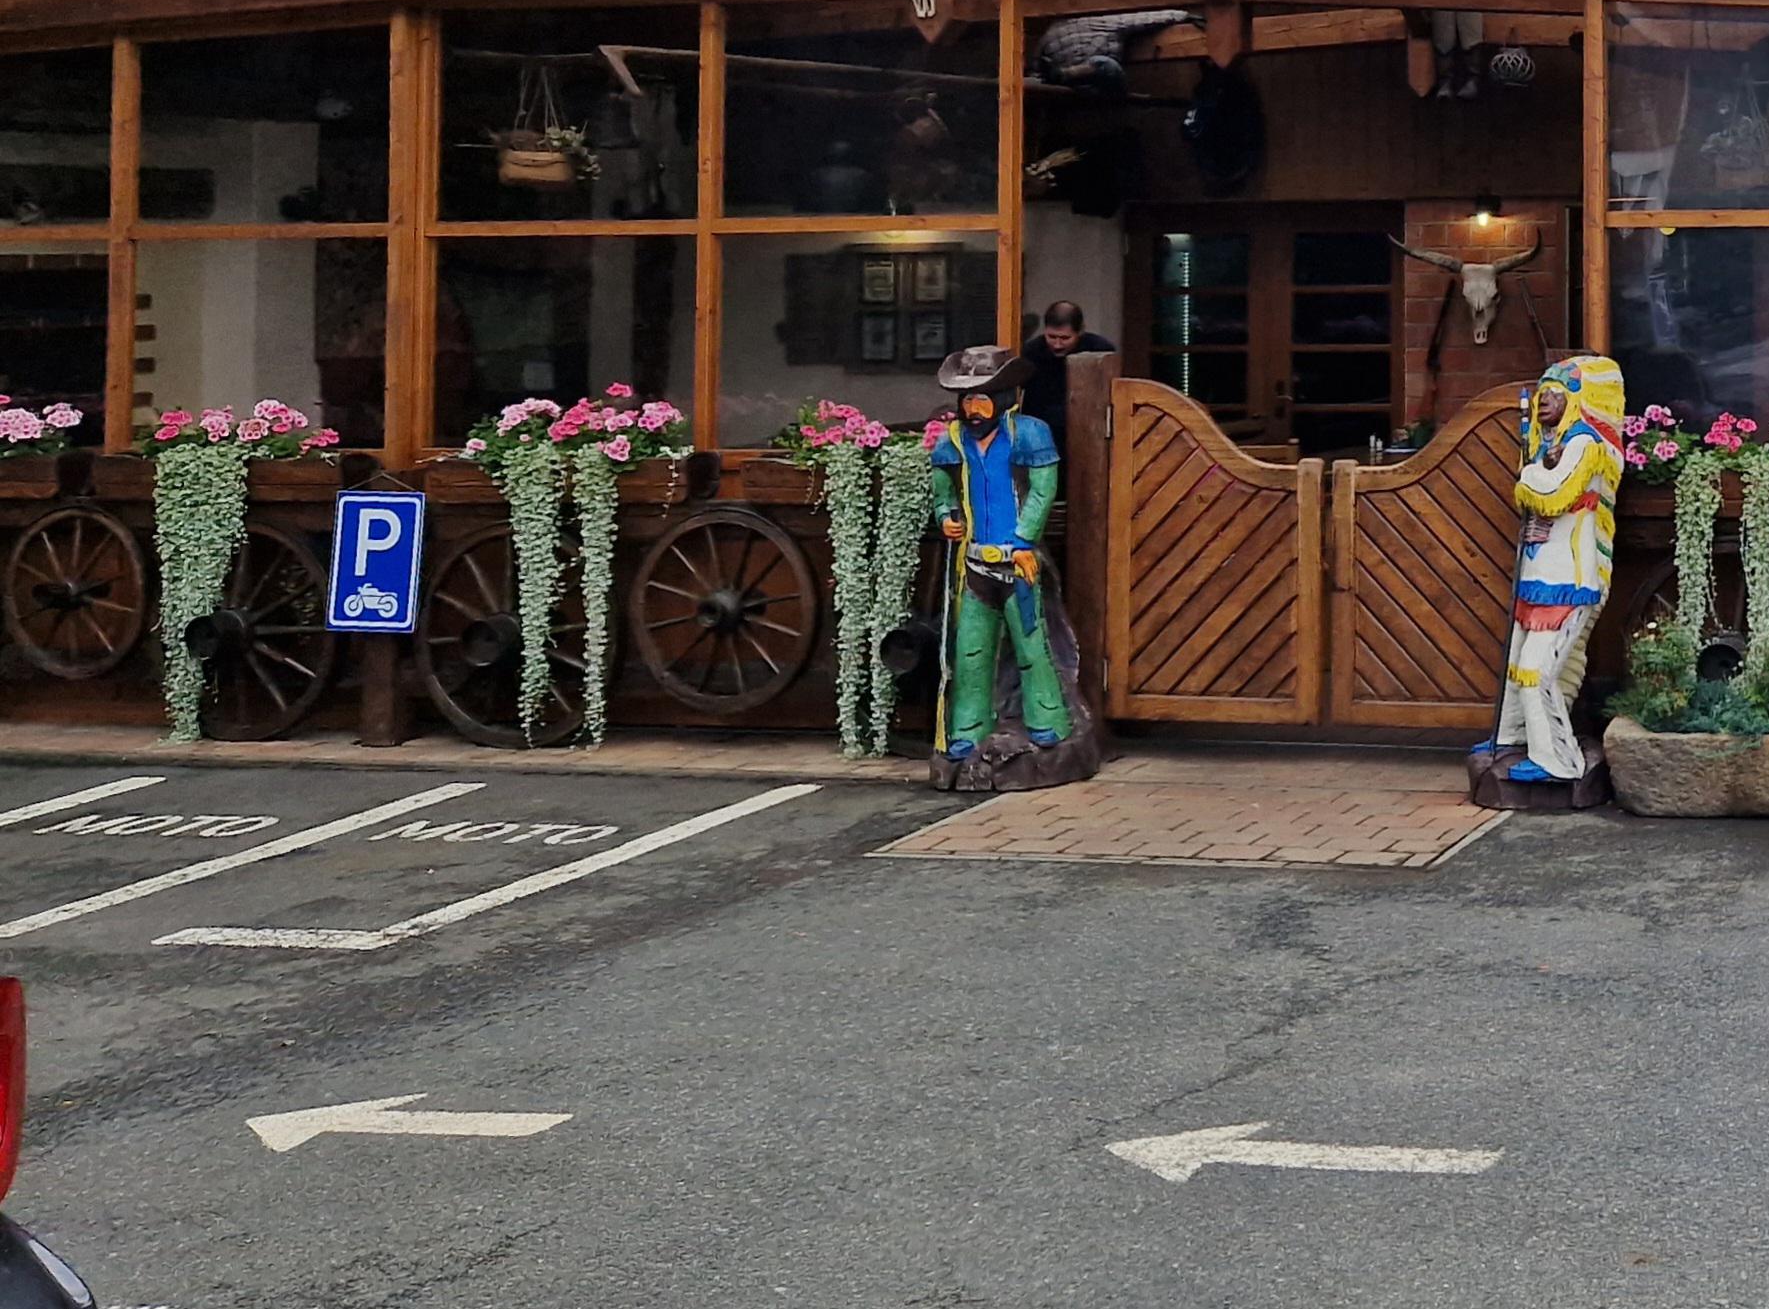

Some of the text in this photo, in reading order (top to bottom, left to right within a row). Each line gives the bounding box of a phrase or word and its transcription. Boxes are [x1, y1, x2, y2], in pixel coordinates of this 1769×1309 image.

[354, 508, 402, 576] P
[32, 813, 280, 838] MOTO
[368, 818, 620, 846] MOTO
